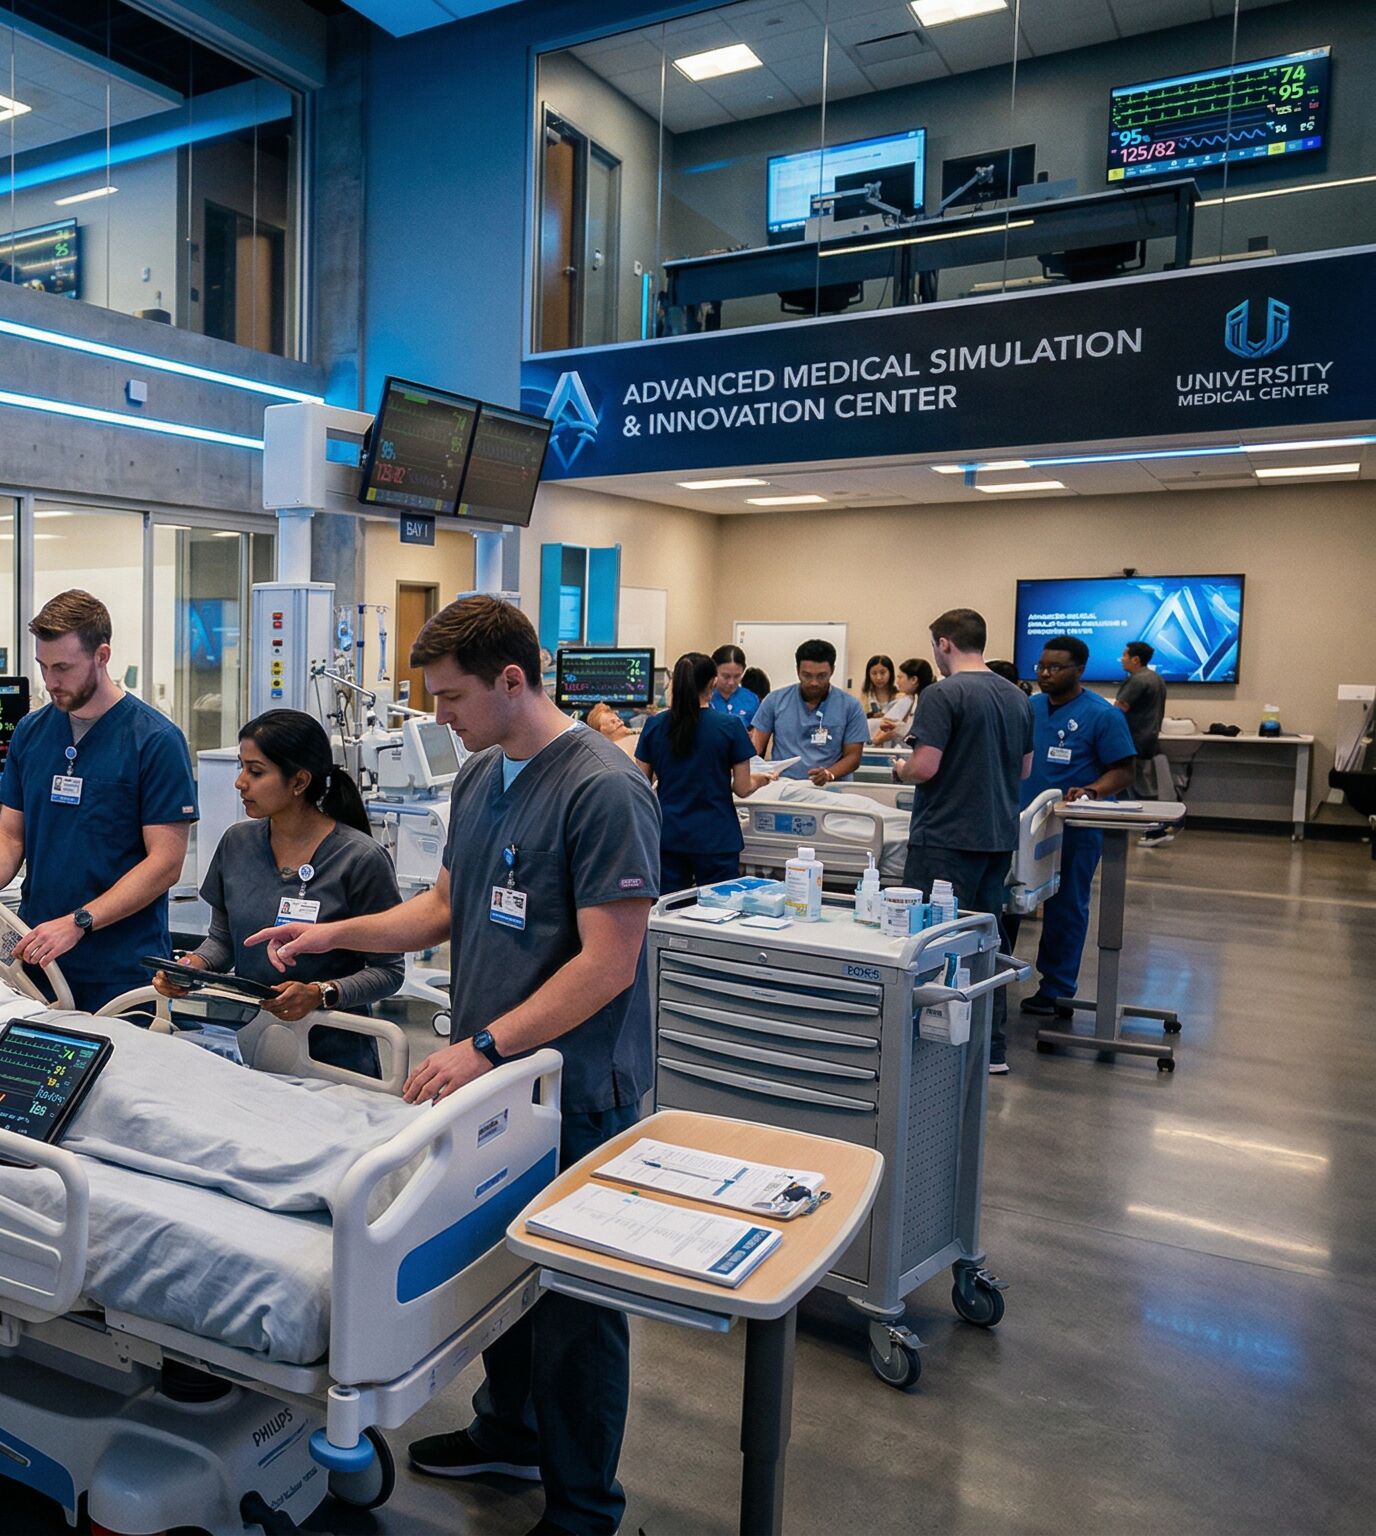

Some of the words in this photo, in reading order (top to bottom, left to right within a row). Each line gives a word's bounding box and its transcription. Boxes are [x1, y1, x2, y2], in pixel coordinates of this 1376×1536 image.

[1280, 65, 1307, 83] 74
[1278, 82, 1304, 101] 95
[1120, 141, 1176, 163] 125/82
[622, 369, 775, 405] ADVANCED
[783, 353, 920, 389] MEDICAL
[929, 327, 1143, 374] SIMULATION
[1176, 361, 1334, 392] UNIVERSITY
[1178, 388, 1255, 407] MEDICAL
[1259, 383, 1330, 400] CENTER
[622, 415, 641, 437] &
[649, 398, 825, 434] INNOVATION
[835, 385, 958, 419] CENTER
[252, 1407, 293, 1447] PHILIPS
